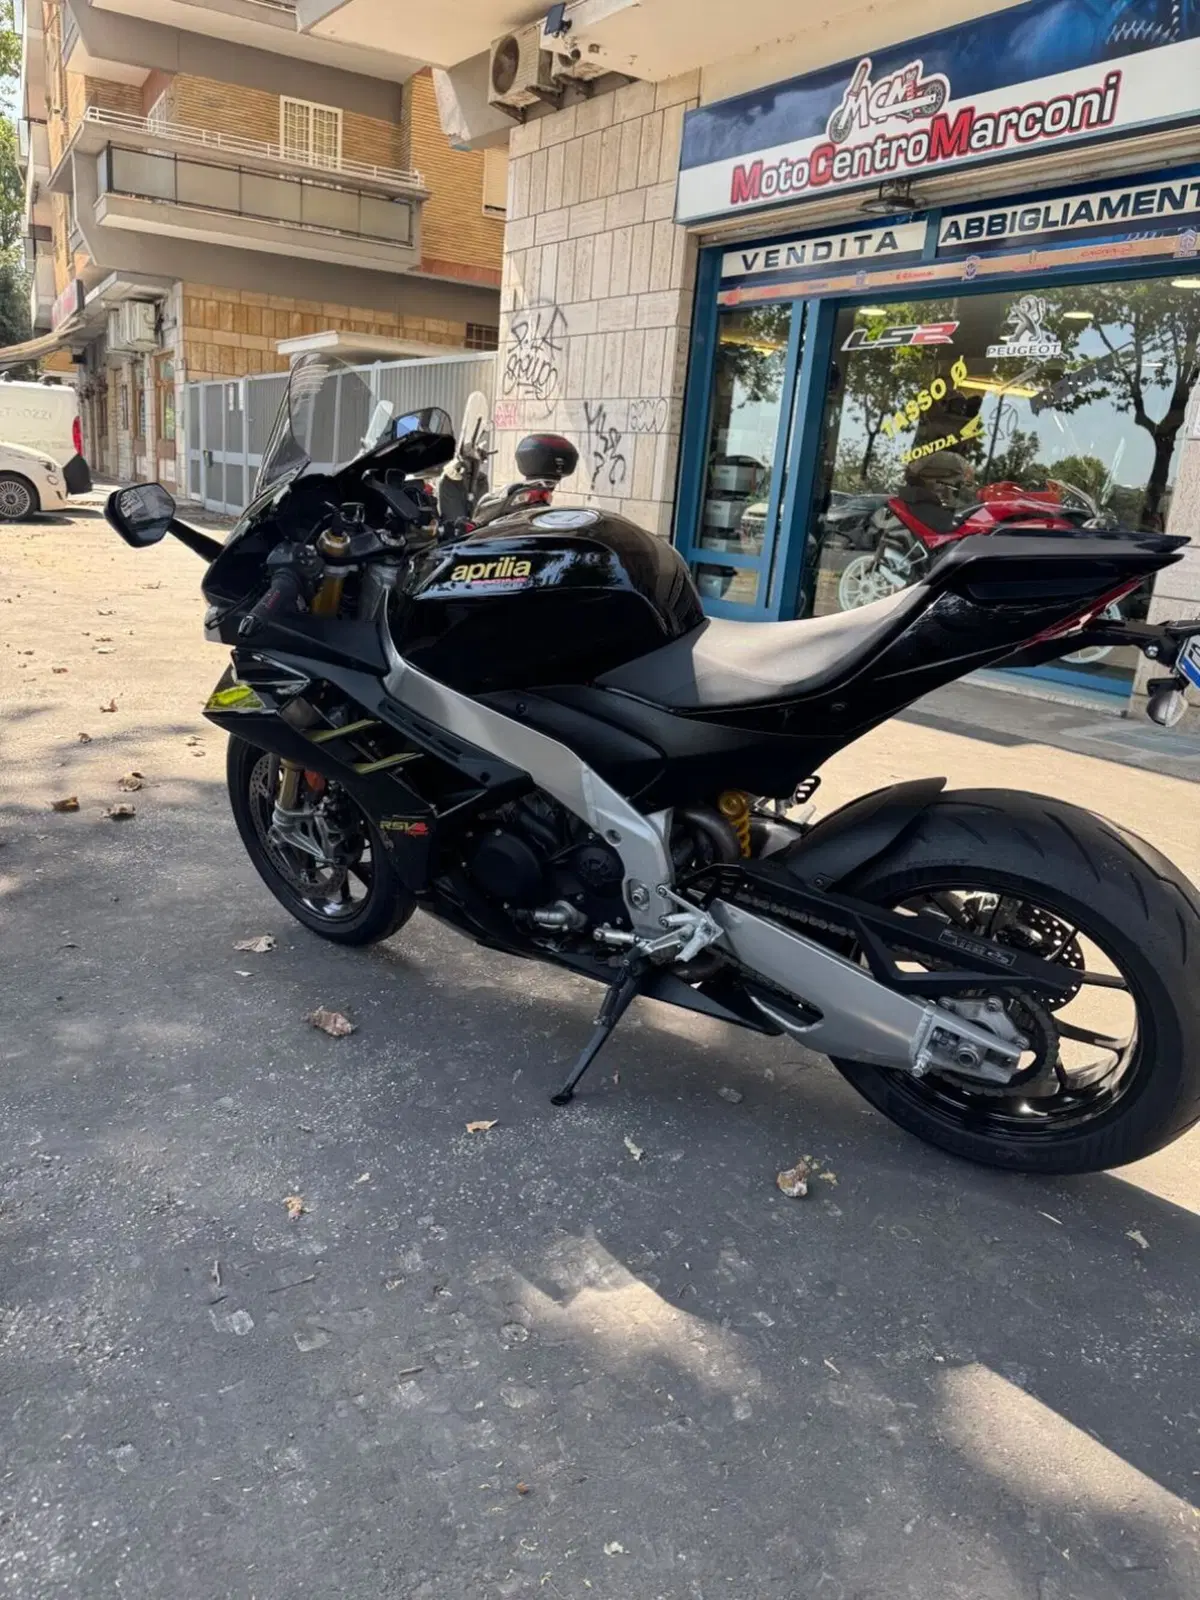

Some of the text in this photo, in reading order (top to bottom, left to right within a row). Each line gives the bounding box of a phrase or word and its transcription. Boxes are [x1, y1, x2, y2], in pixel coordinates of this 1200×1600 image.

[741, 231, 898, 271] VENDITA
[841, 321, 960, 351] LS2
[986, 343, 1061, 357] PEUGEOT
[901, 434, 958, 464] HONDA
[451, 556, 531, 583] aprilia
